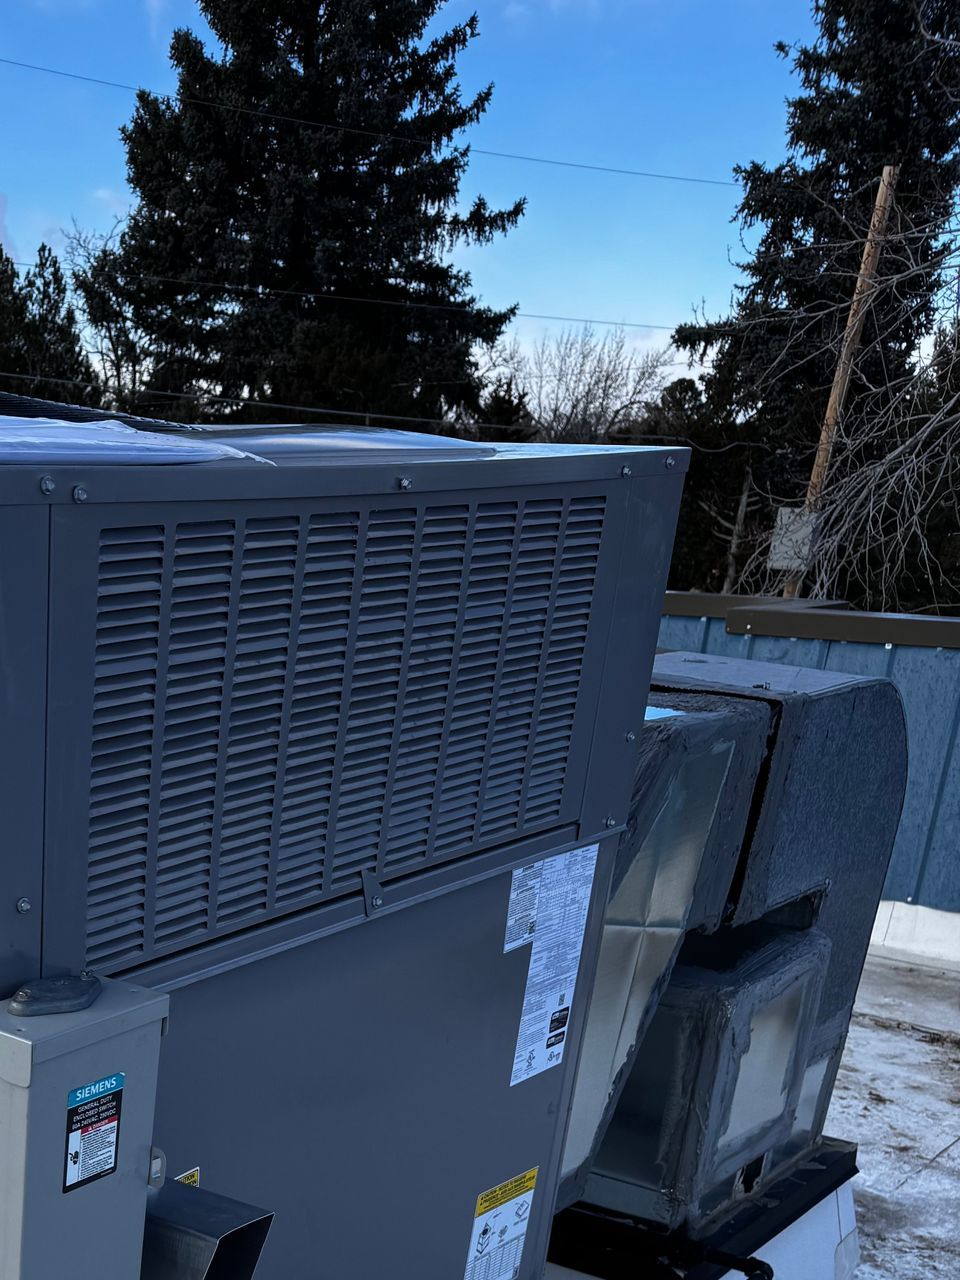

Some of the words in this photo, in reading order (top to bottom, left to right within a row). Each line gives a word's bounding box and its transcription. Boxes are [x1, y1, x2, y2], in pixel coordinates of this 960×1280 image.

[76, 1077, 117, 1100] SIEMENS
[73, 1108, 98, 1122] ENCLOSED
[99, 1101, 116, 1112] SWITCH
[78, 1100, 99, 1113] GENERAL
[100, 1095, 112, 1105] DUTY
